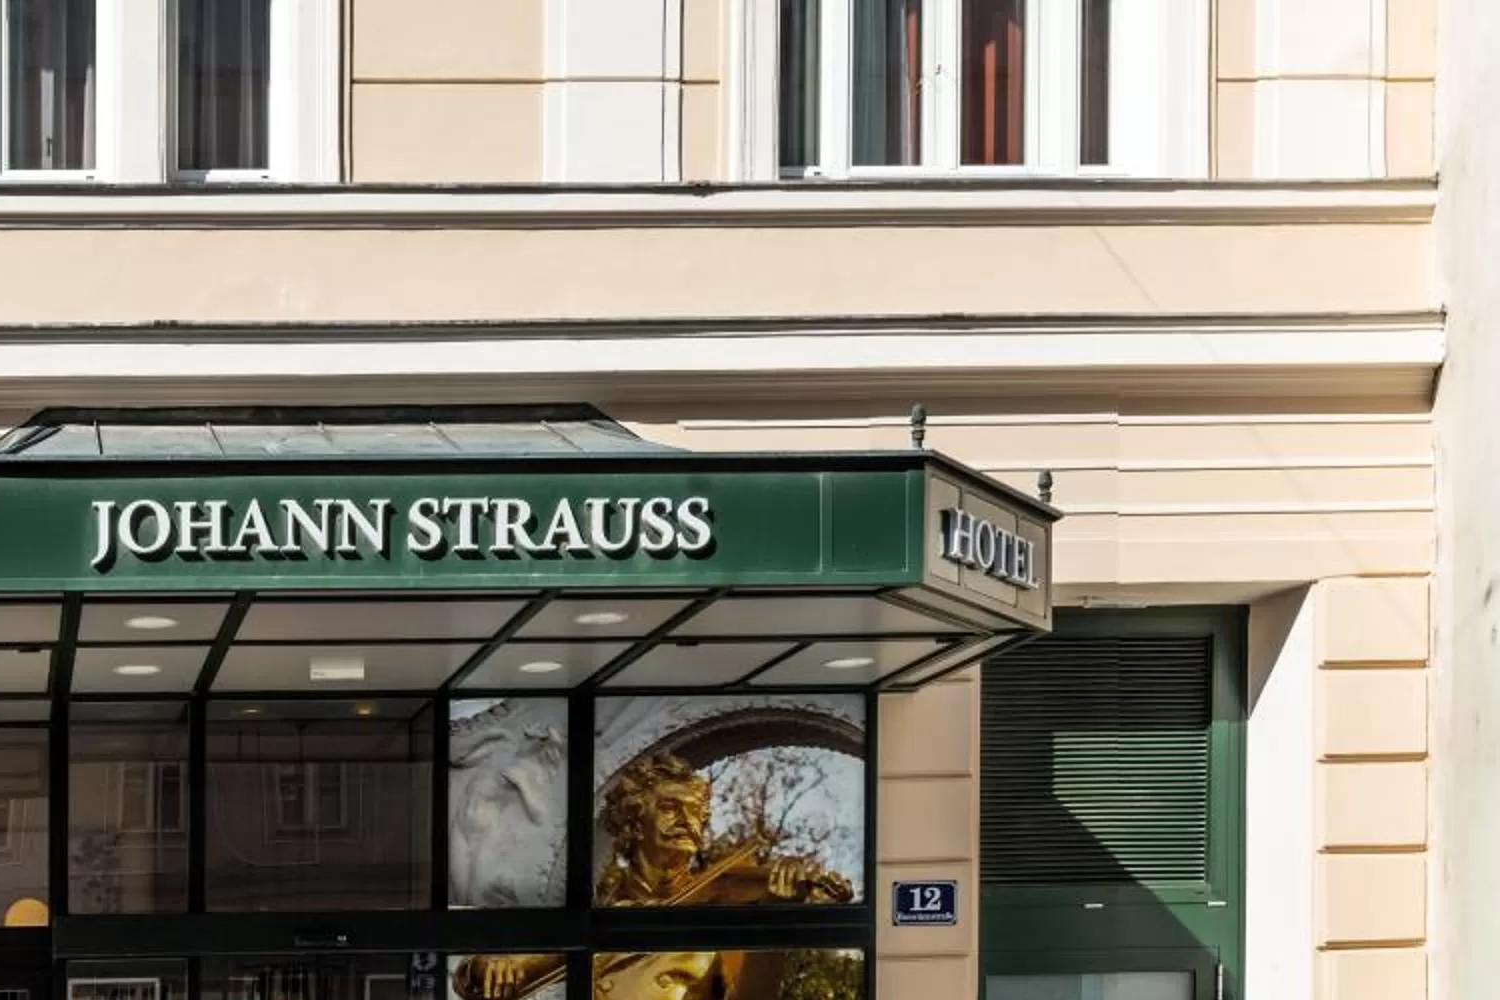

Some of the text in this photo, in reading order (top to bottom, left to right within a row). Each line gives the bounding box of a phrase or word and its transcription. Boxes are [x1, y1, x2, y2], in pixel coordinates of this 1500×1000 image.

[91, 496, 713, 571] JOHANN STRAUSS
[946, 508, 1041, 590] HOTEL
[908, 886, 942, 912] 12
